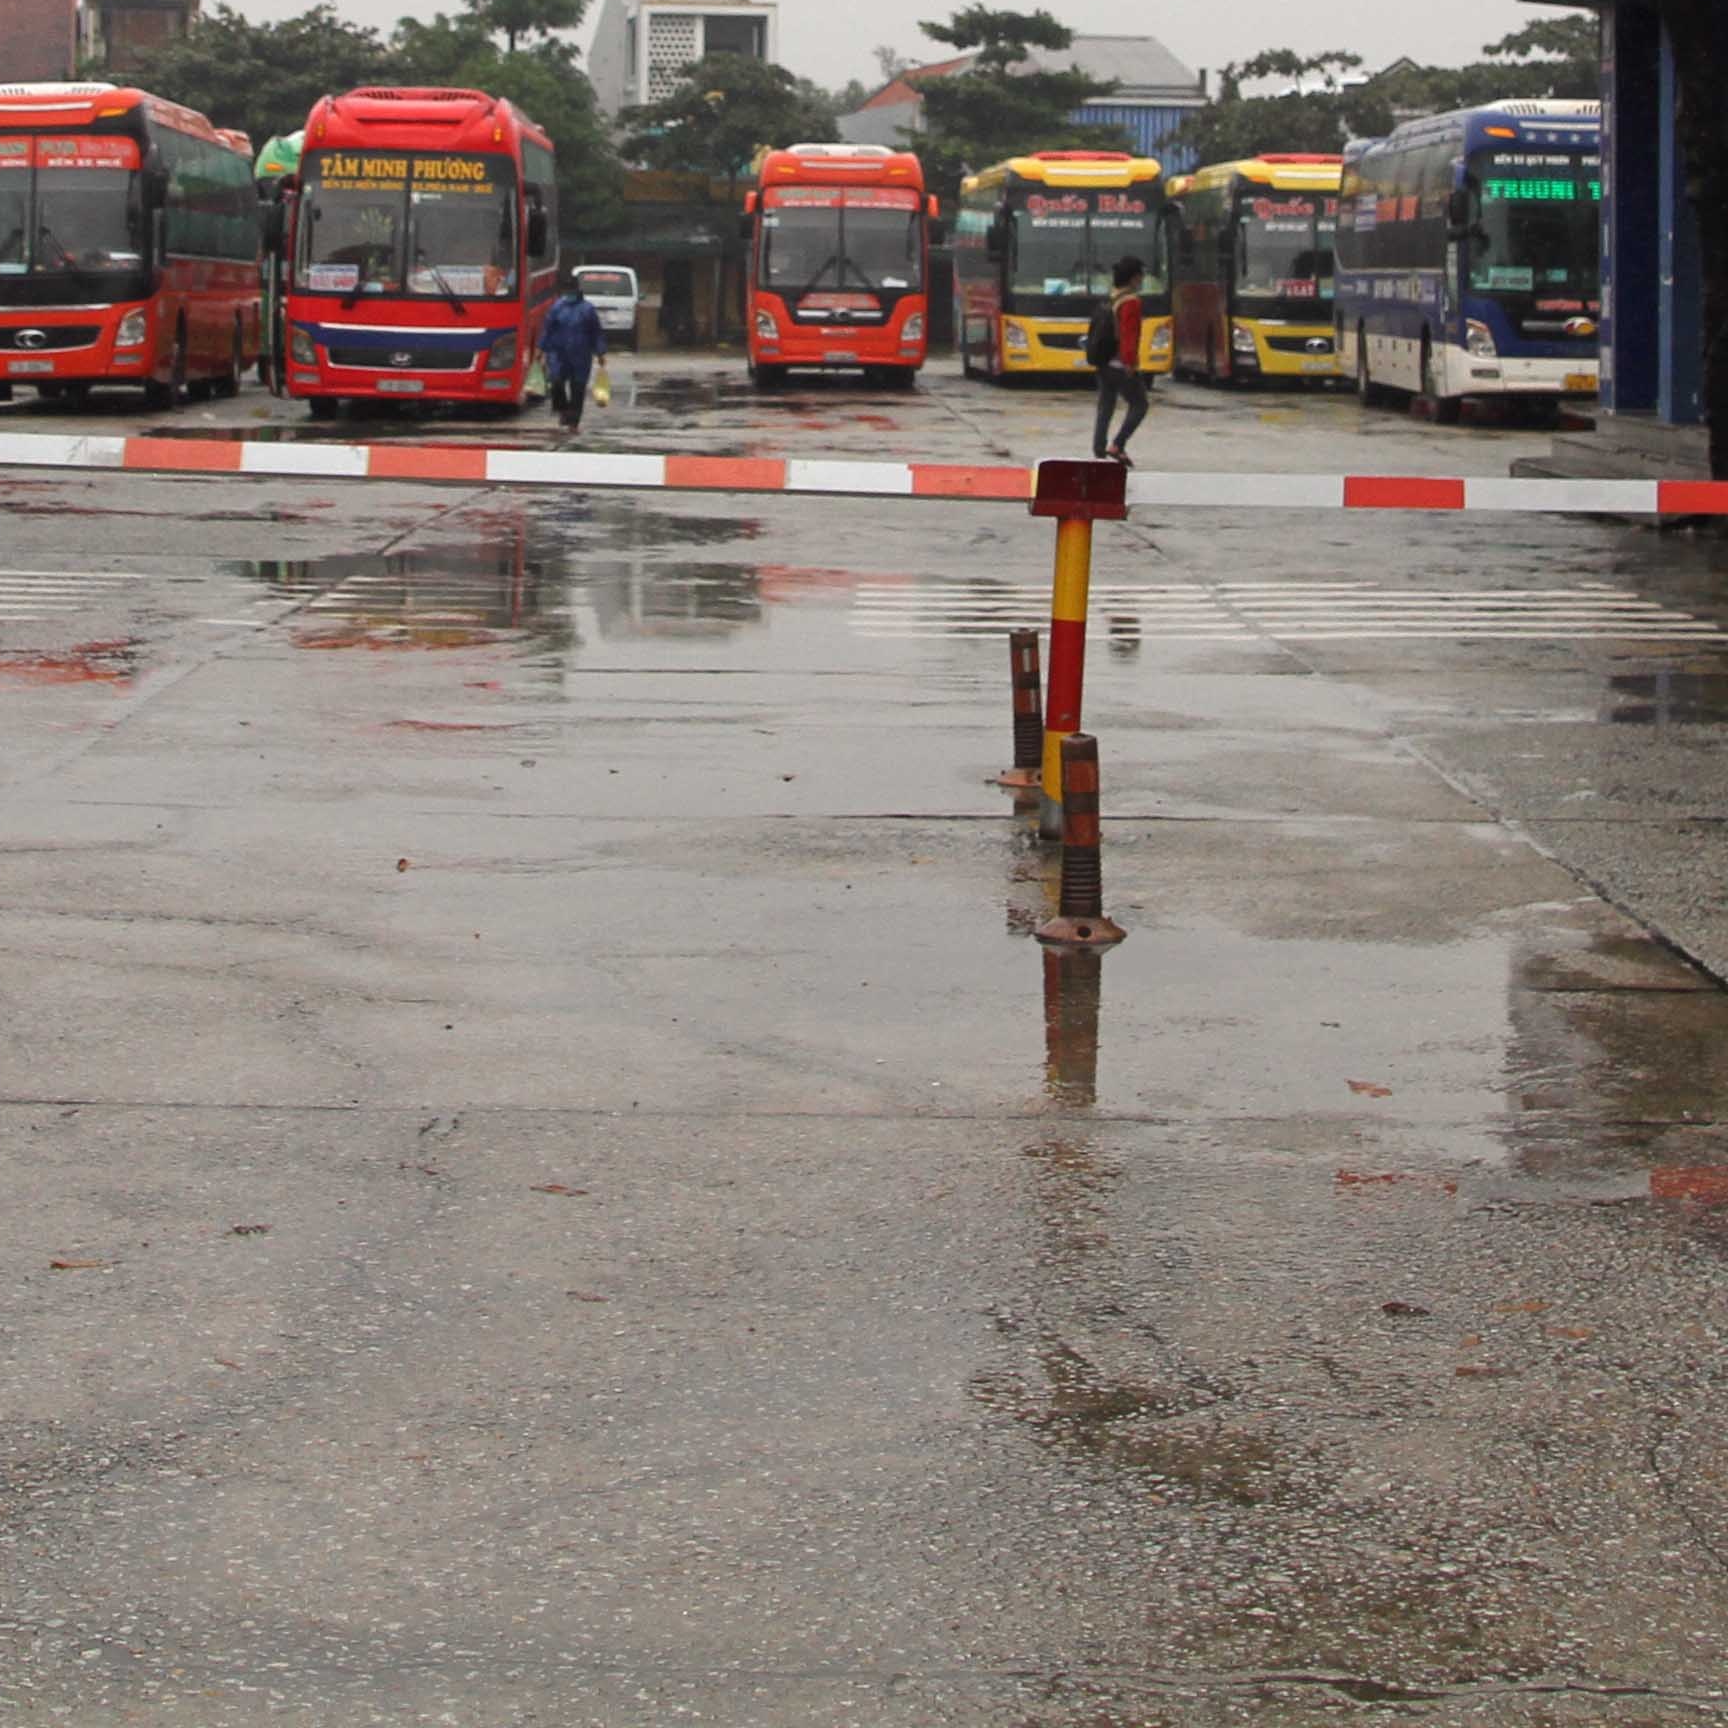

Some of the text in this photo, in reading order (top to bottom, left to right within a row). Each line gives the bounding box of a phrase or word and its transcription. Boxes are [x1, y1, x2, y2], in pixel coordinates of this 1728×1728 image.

[320, 153, 360, 177] TÂM
[362, 158, 408, 178] MINH
[1027, 192, 1146, 218] Quốc Bảo
[1252, 196, 1315, 220] Quốc
